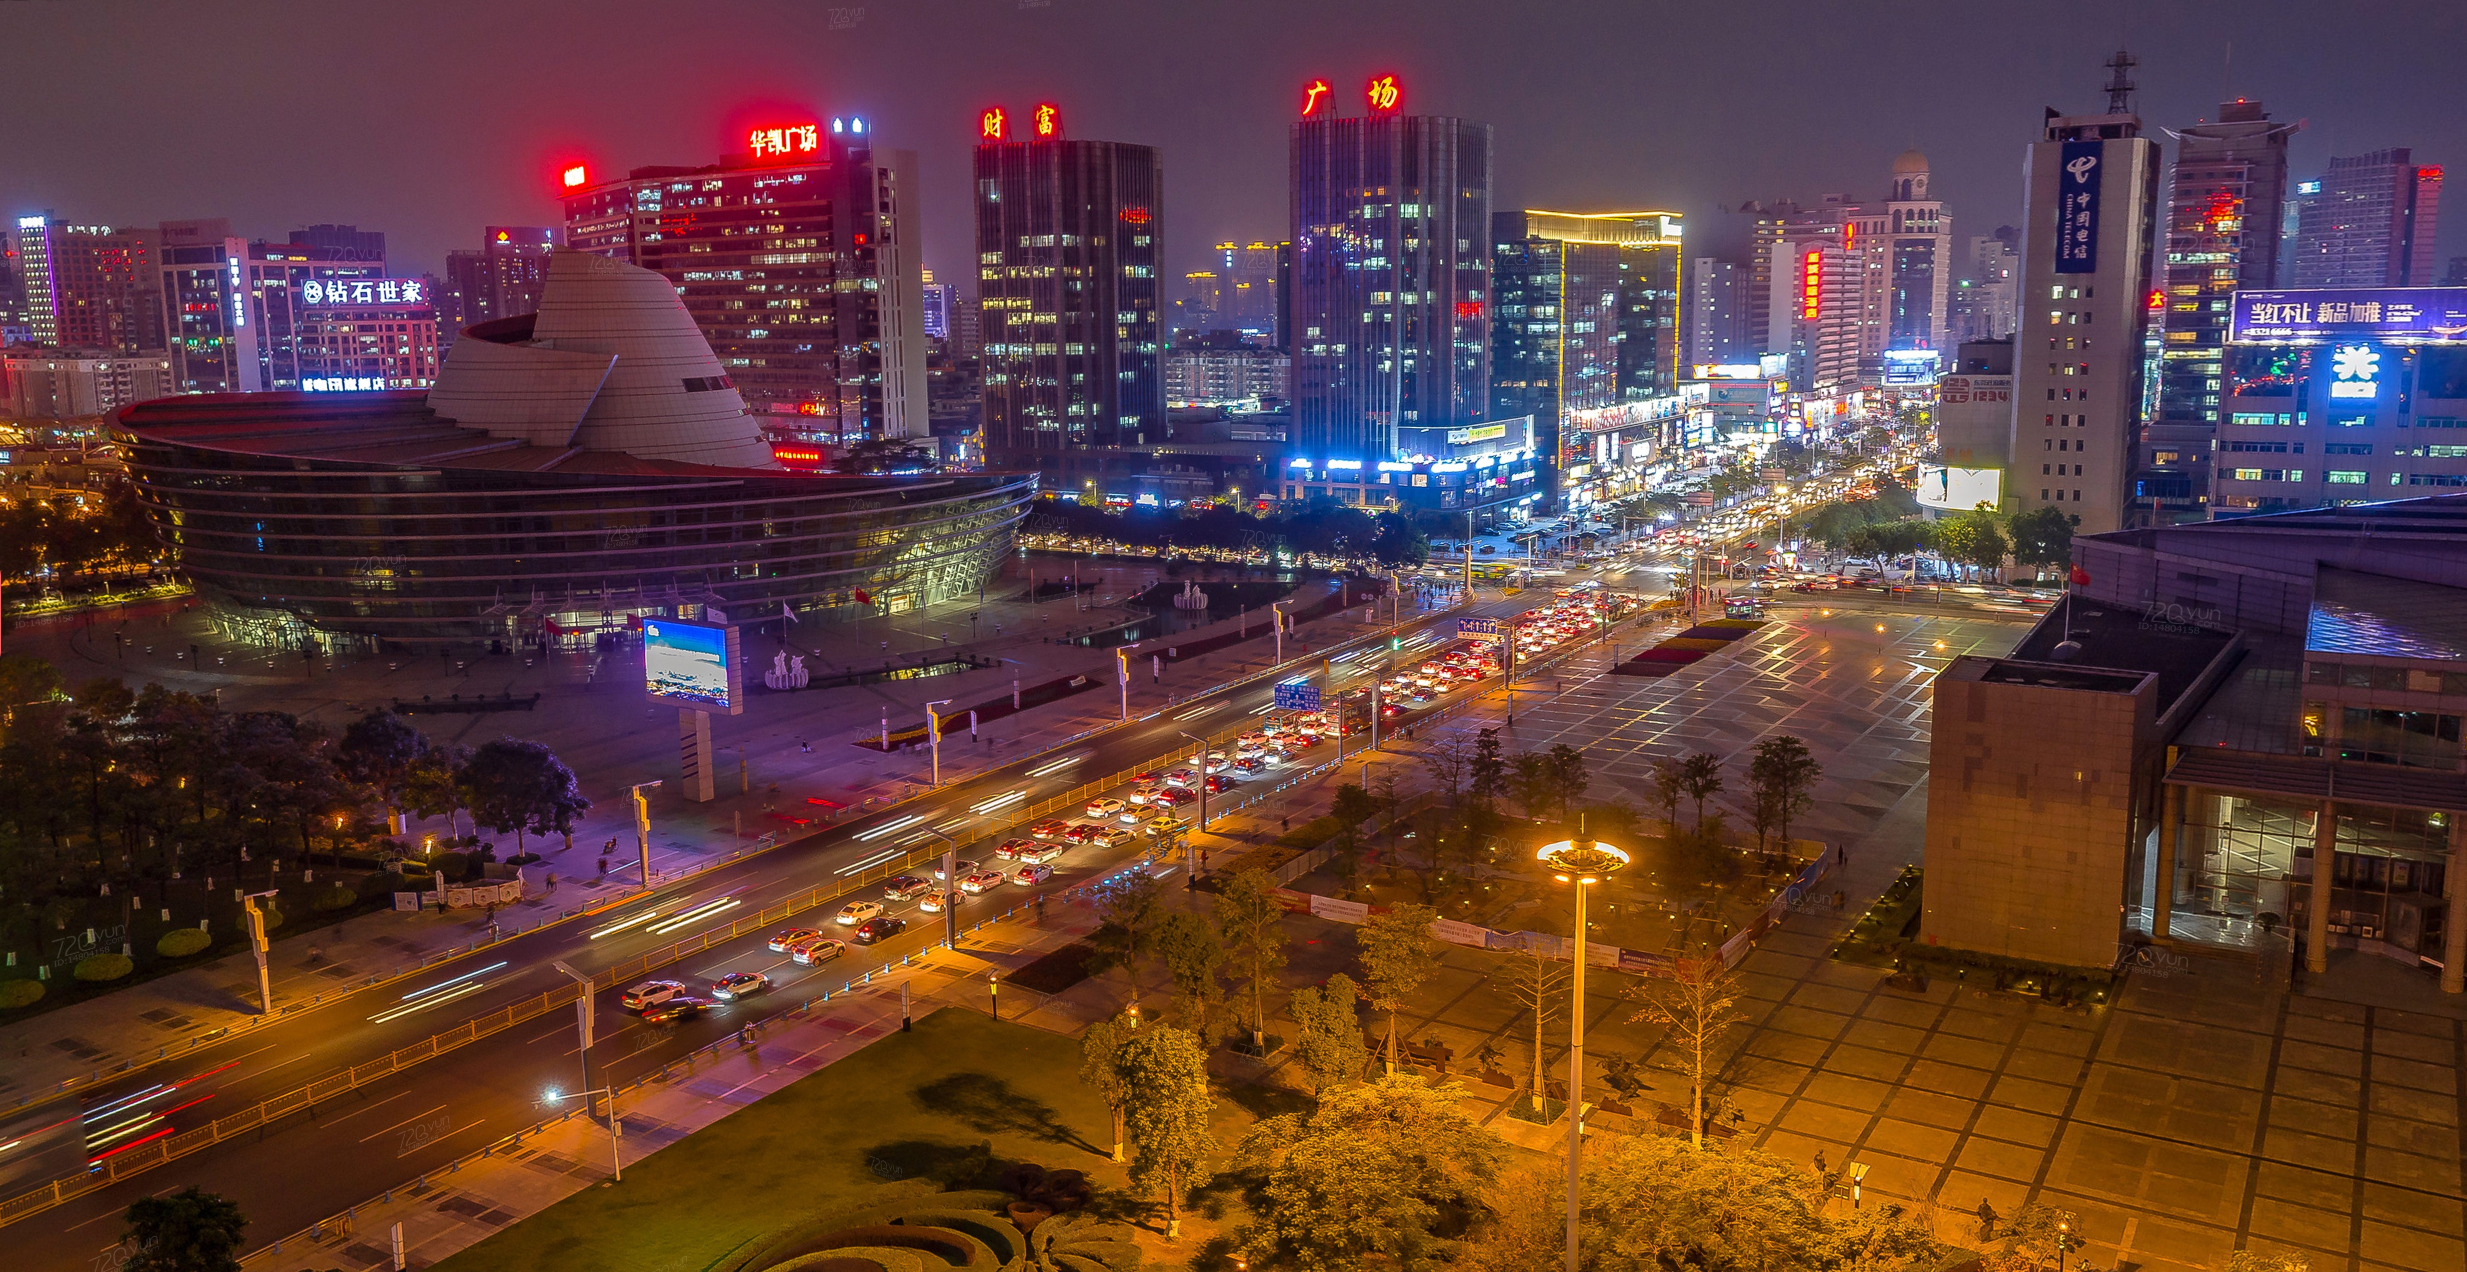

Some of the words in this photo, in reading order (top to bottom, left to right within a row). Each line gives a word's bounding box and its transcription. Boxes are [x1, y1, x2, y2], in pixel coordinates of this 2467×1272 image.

[750, 124, 818, 157] 华凯广场
[2065, 193, 2074, 219] CHINA
[2074, 191, 2091, 259] 中国电信
[2062, 221, 2073, 259] TELECOM
[325, 280, 424, 304] 钻石世家
[2250, 302, 2312, 325] 当红不让
[2316, 302, 2382, 323] 新品加推
